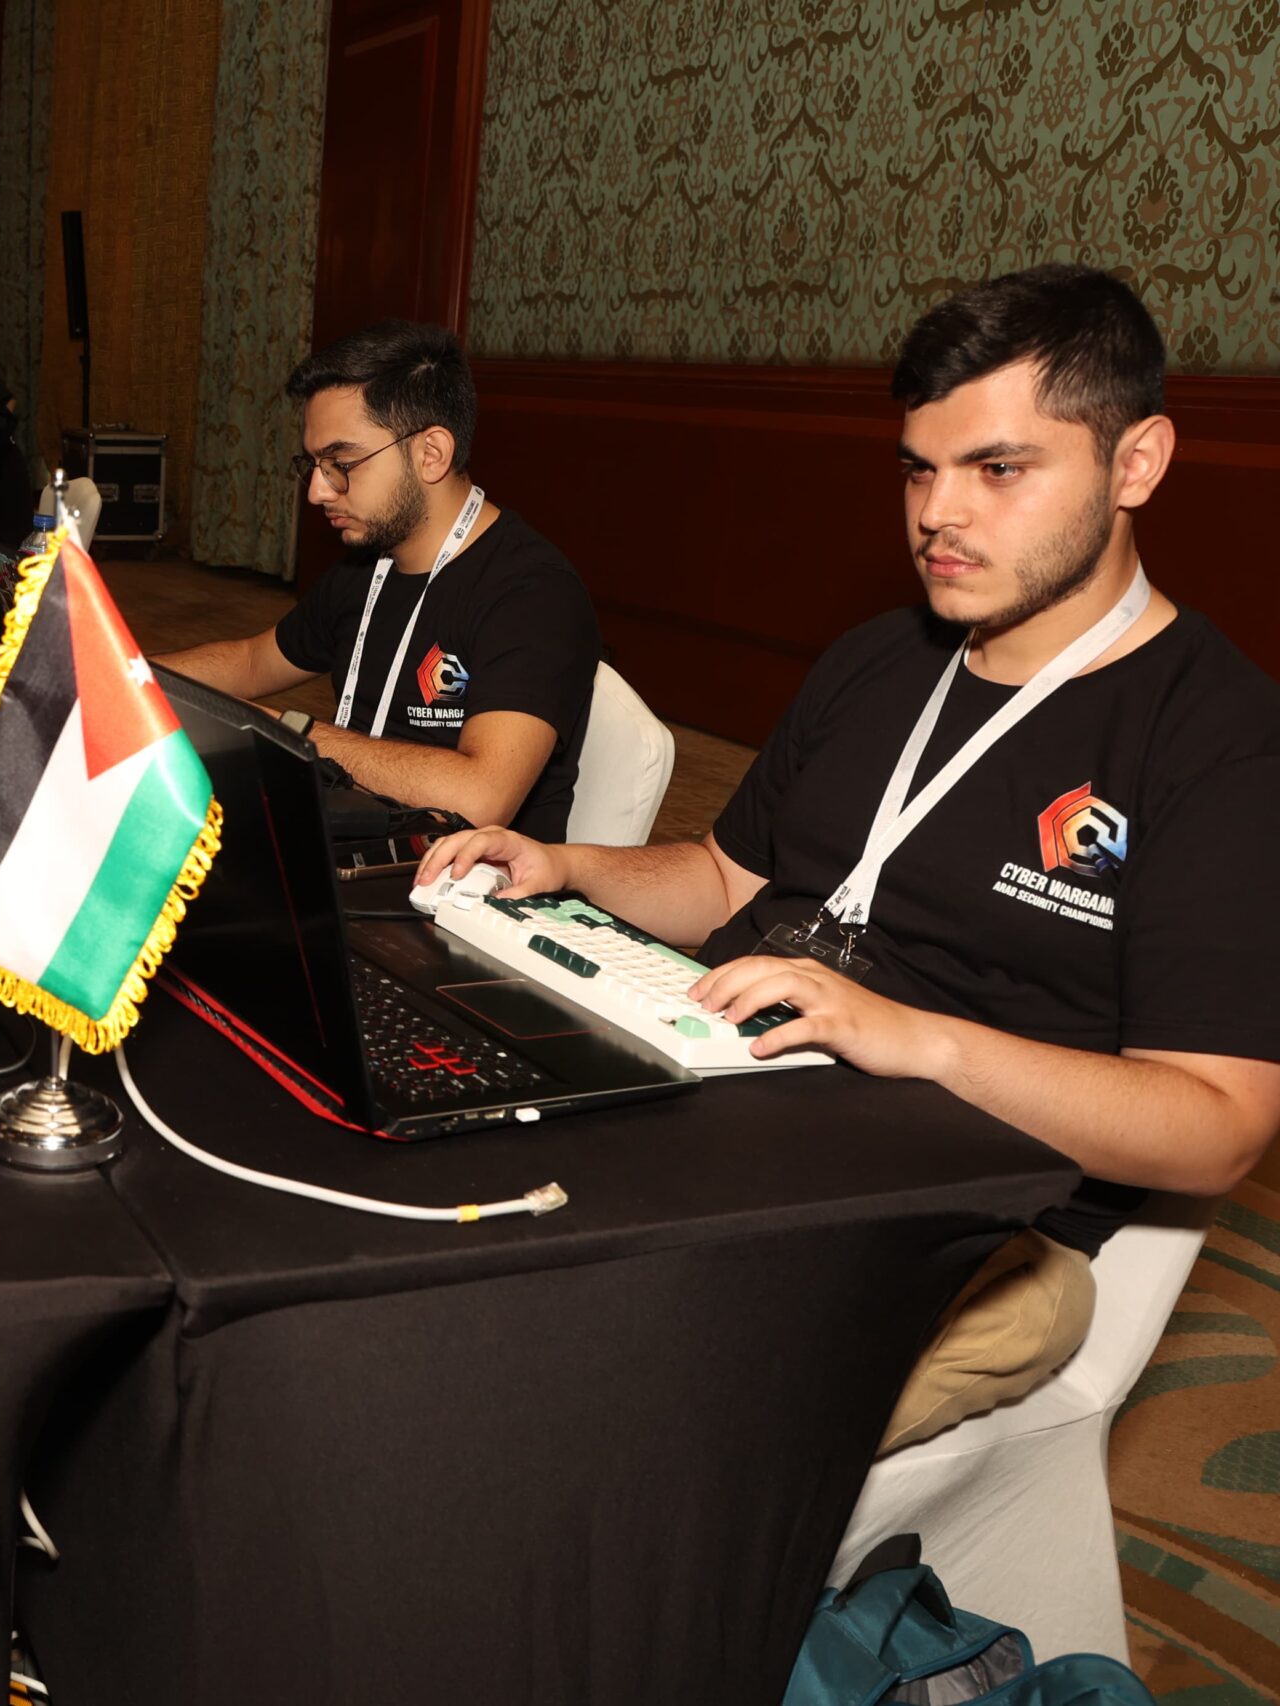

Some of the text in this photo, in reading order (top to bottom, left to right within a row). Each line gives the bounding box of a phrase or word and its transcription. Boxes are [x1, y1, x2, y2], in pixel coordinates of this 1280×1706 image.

[407, 705, 433, 719] CYBER
[420, 720, 445, 728] SECURITY
[1000, 862, 1049, 892] CYBER
[992, 880, 1018, 898] ARAB
[1016, 889, 1060, 913] SECURITY
